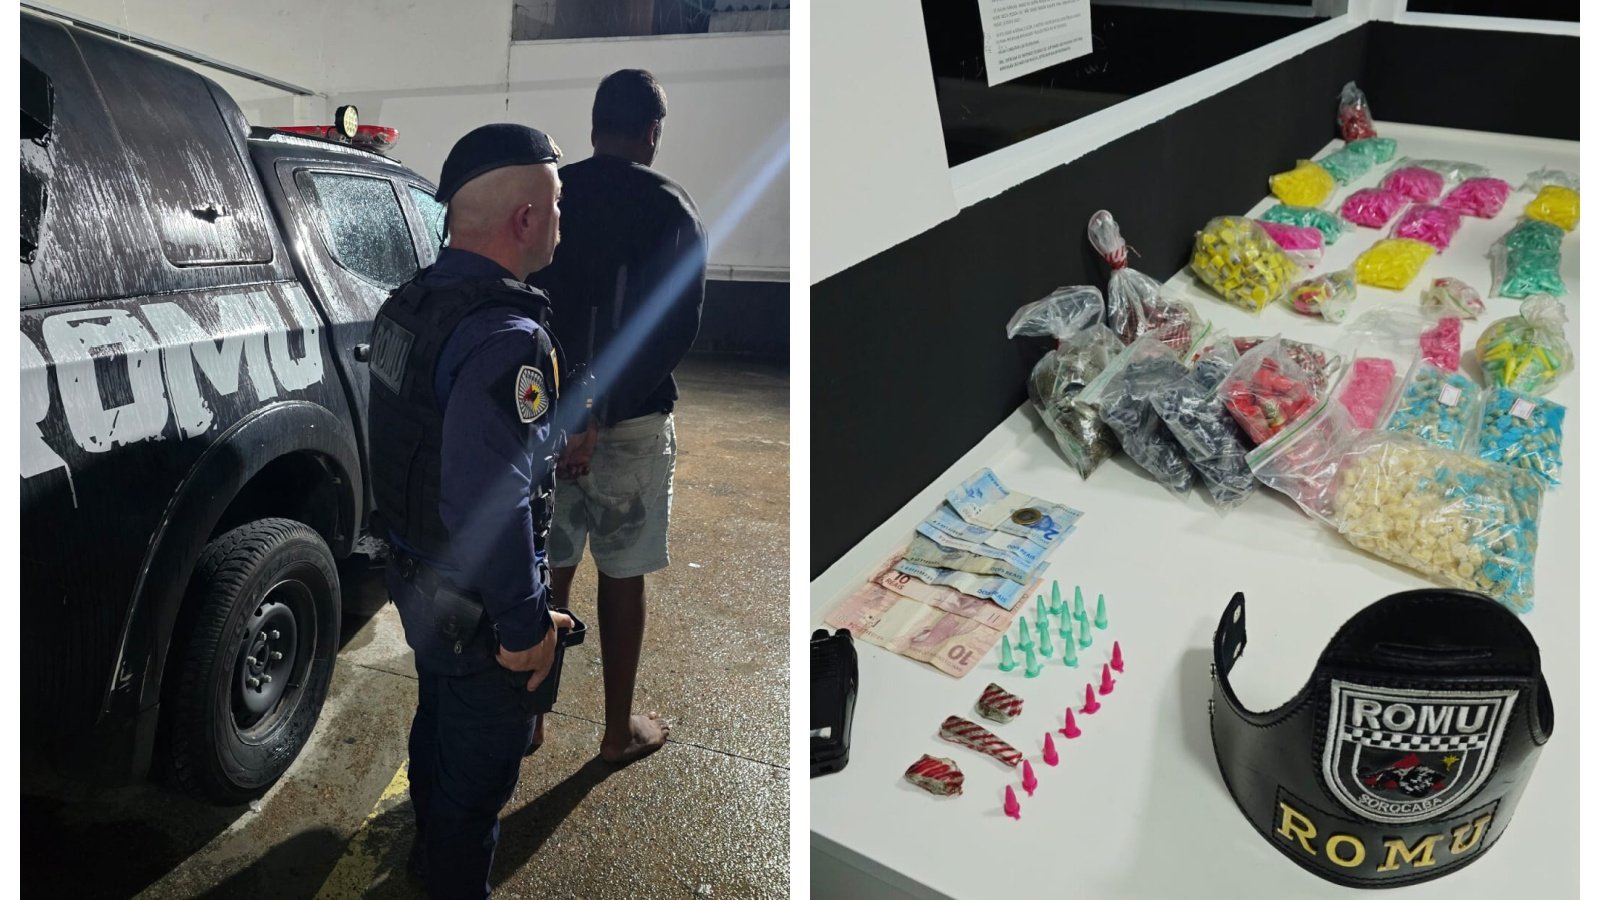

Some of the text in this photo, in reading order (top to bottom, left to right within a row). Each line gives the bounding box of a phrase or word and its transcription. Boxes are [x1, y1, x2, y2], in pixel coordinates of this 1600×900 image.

[371, 323, 409, 381] ROMU
[885, 579, 905, 591] REAIS
[893, 571, 910, 585] 10
[947, 644, 975, 667] 10
[1351, 697, 1489, 735] ROMU
[1358, 793, 1443, 815] SOROCABA
[1276, 802, 1492, 873] ROMU
